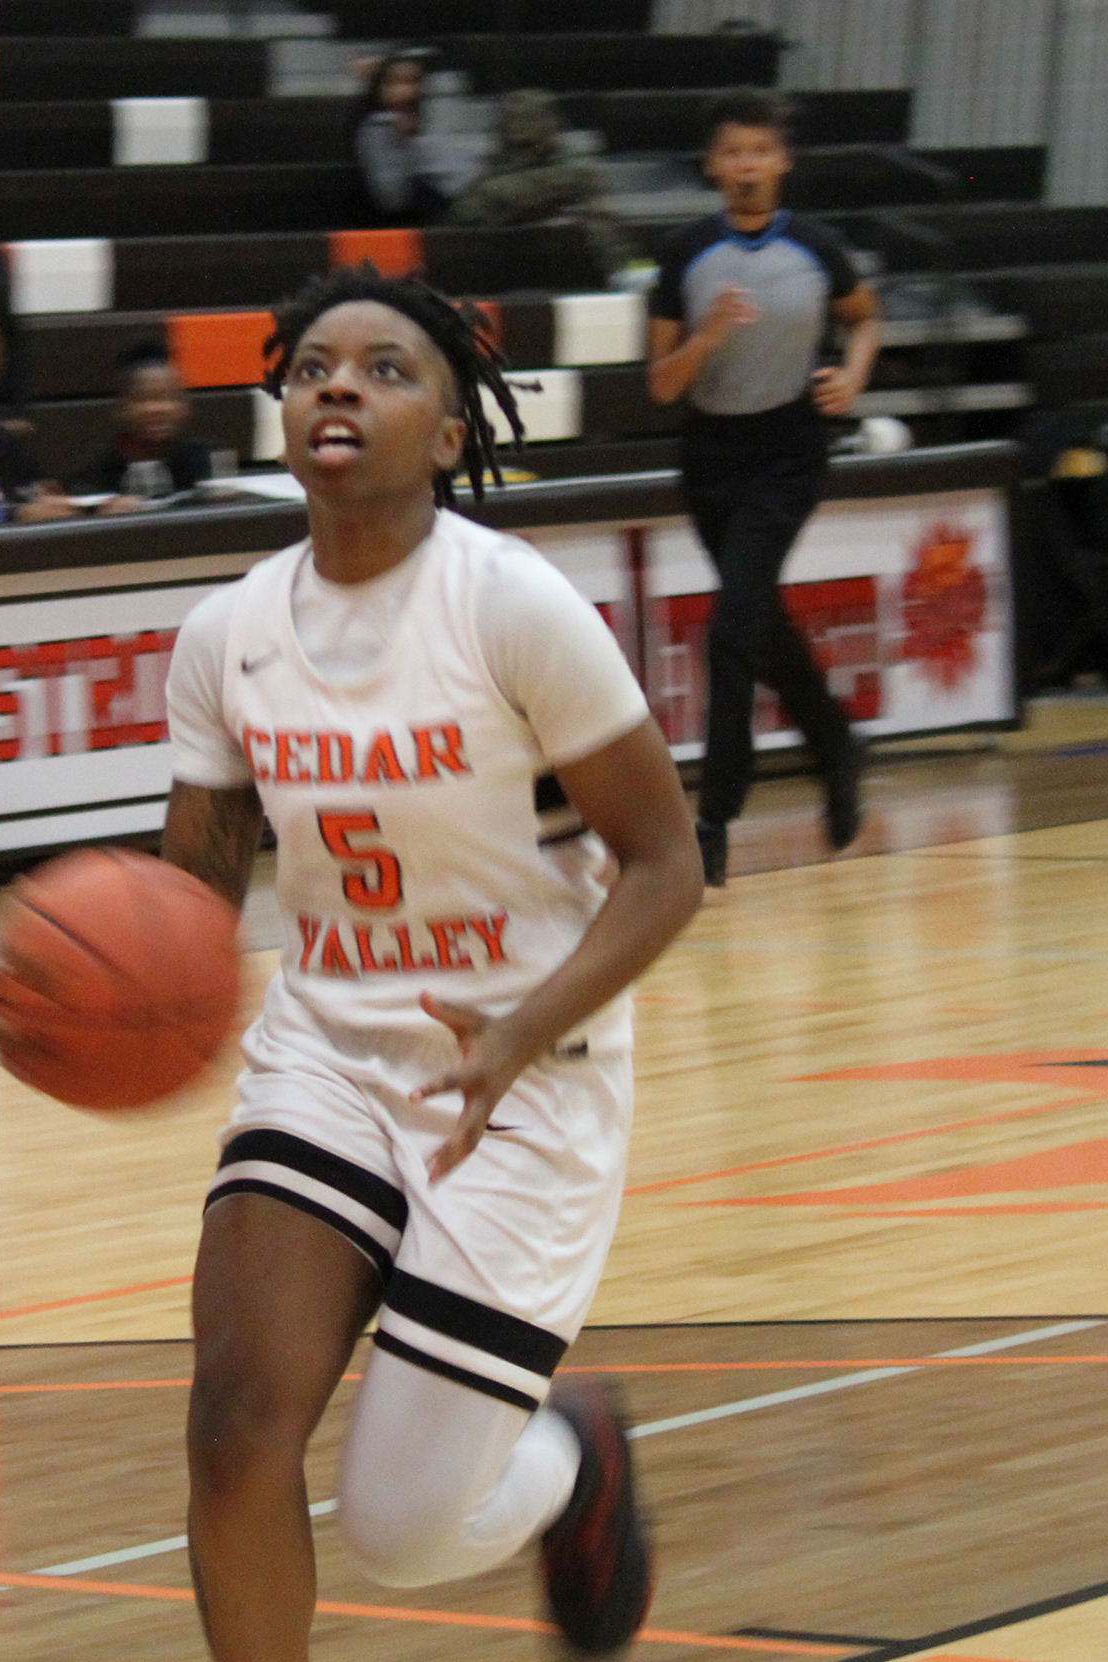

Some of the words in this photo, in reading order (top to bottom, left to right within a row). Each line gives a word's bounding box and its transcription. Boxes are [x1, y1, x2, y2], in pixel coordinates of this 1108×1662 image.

[242, 719, 474, 787] CEDAR
[316, 807, 403, 914] 5
[297, 911, 510, 979] VALLEY
